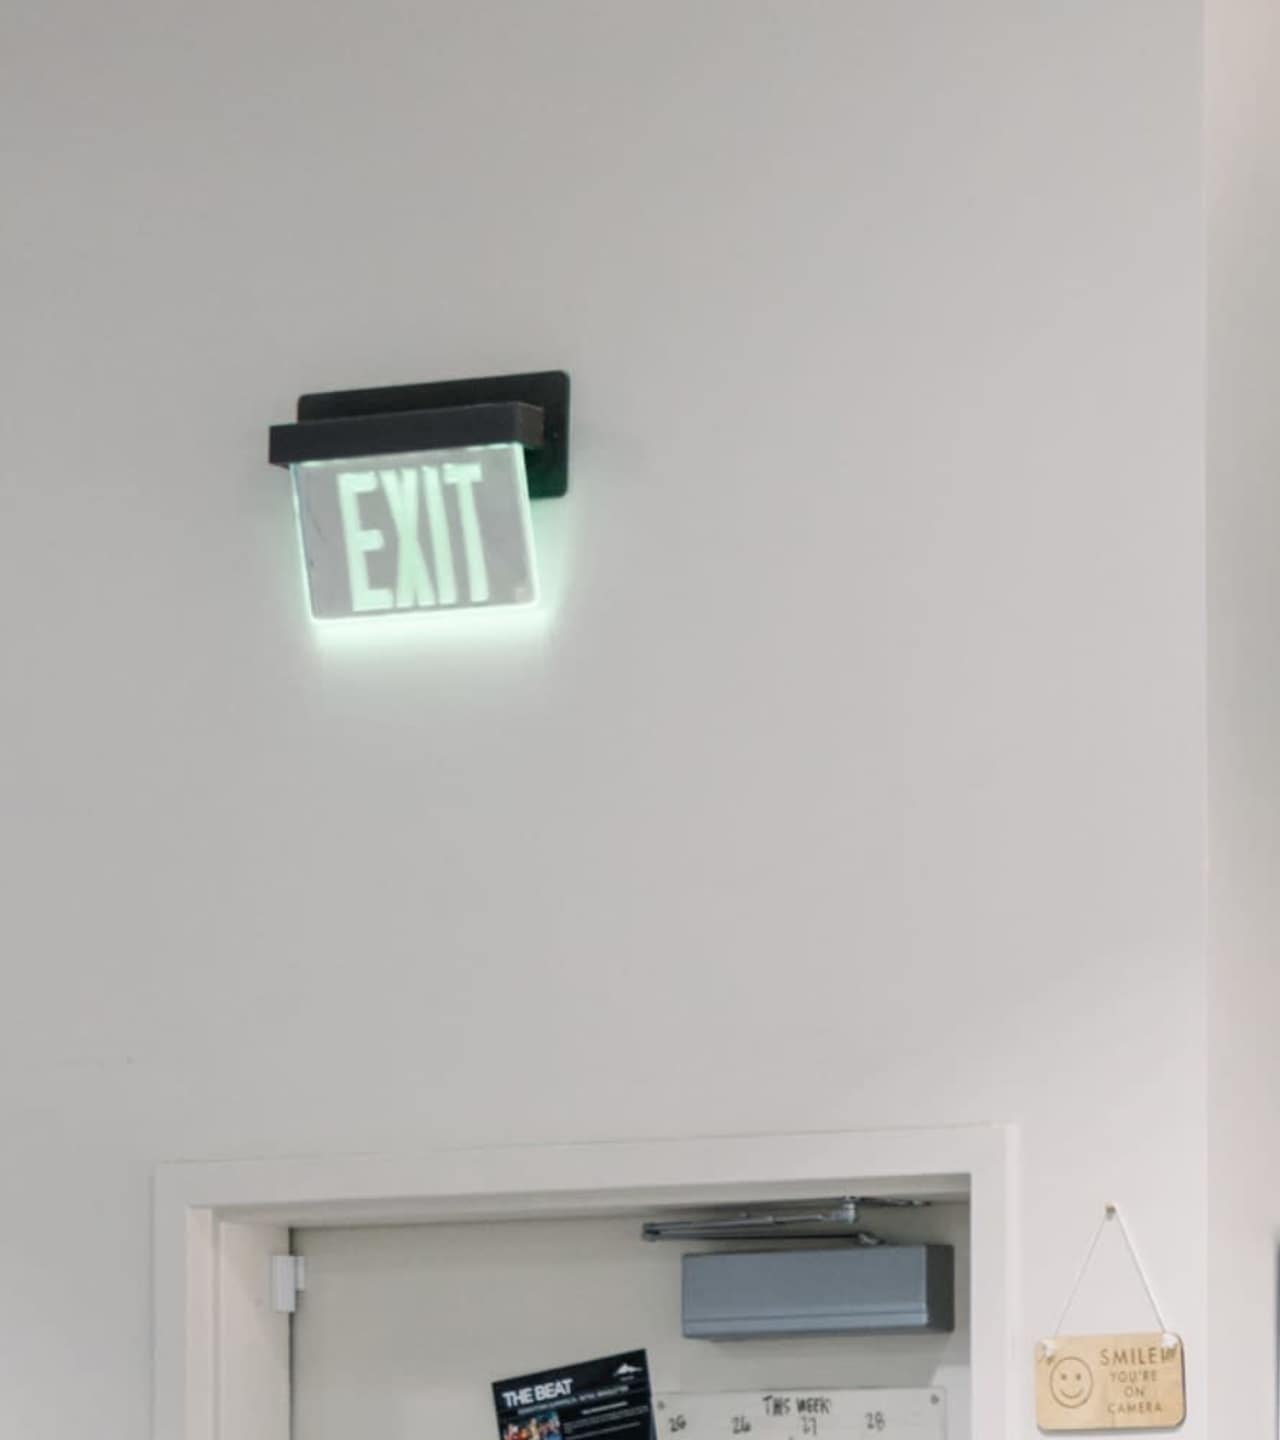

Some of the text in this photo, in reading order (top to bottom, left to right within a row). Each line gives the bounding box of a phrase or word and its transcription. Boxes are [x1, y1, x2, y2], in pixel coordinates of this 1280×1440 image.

[336, 463, 489, 612] EXIT
[1110, 1370, 1158, 1383] YOU'RE
[502, 1386, 534, 1409] THE
[534, 1377, 574, 1403] BEAT
[1123, 1386, 1145, 1398] ON
[1107, 1402, 1164, 1414] CAMERA
